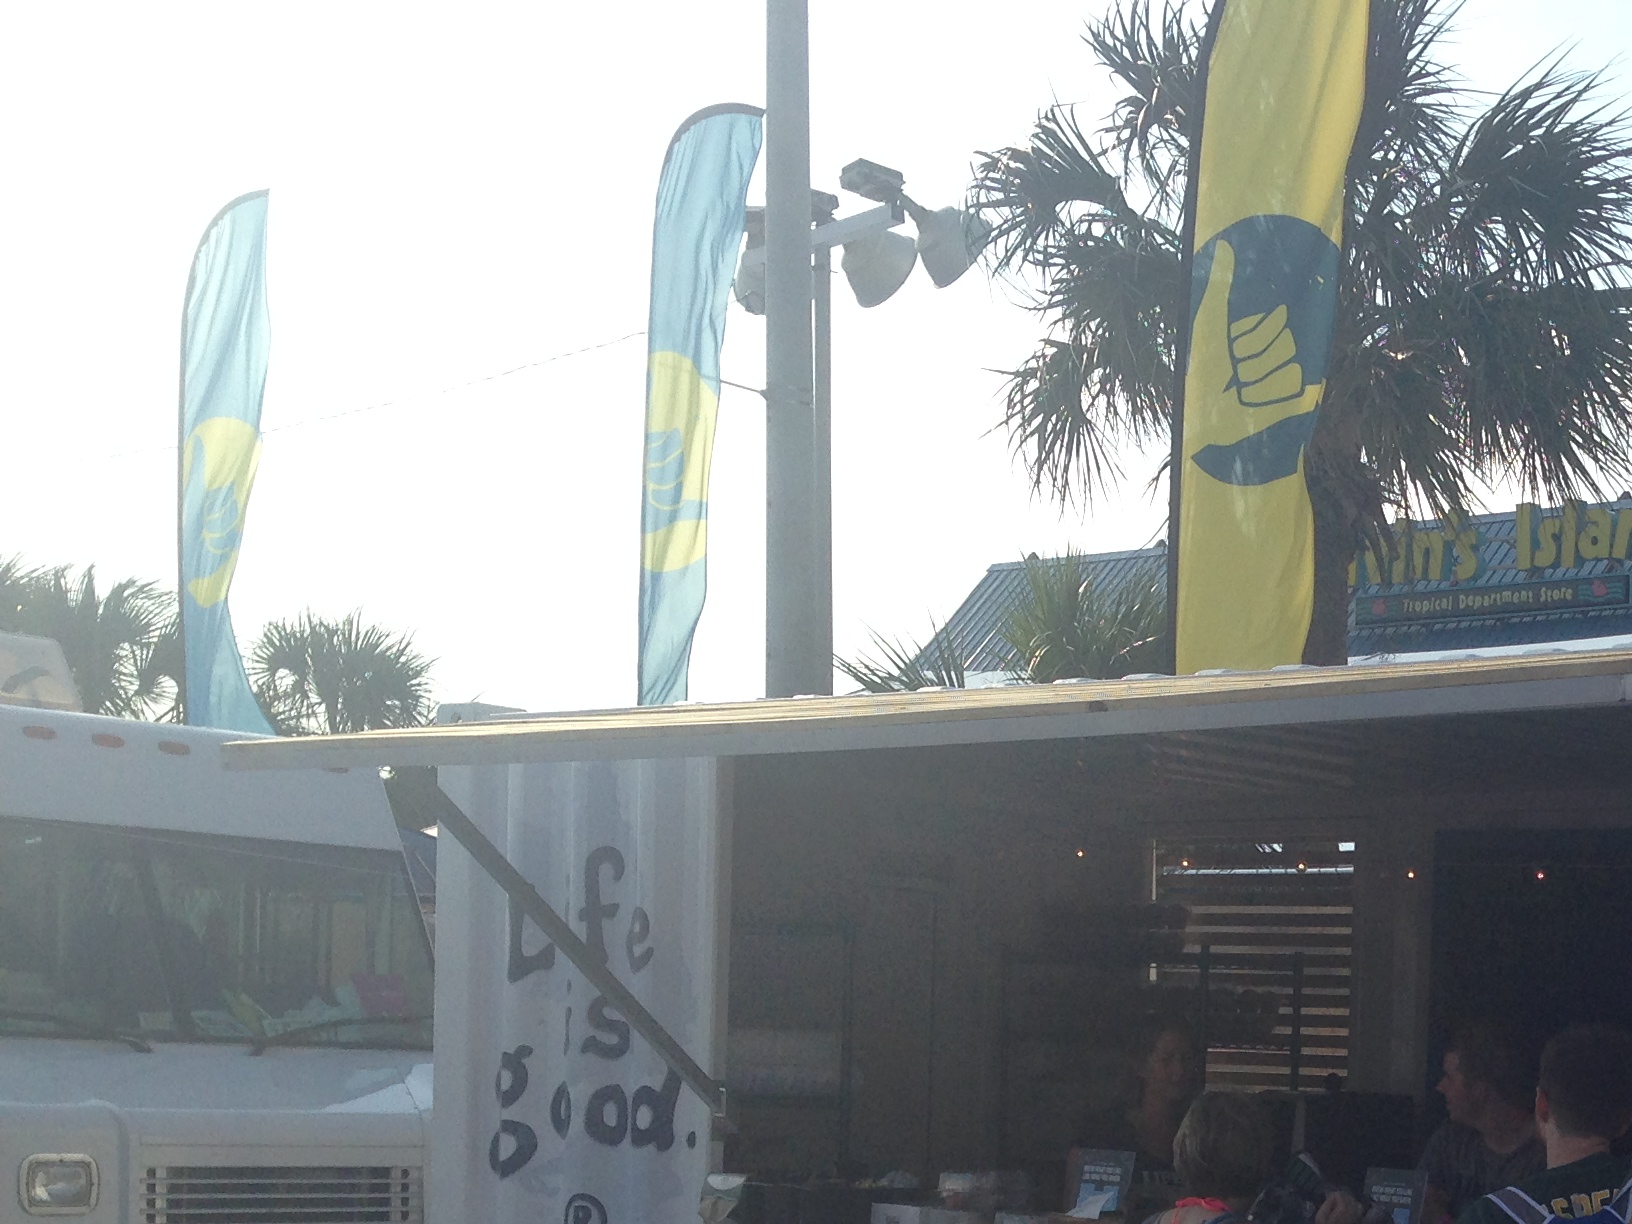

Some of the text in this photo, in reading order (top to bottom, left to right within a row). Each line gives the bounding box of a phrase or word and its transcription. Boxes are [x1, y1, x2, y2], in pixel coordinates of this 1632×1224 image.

[1403, 587, 1573, 614] Tropical Department Store
